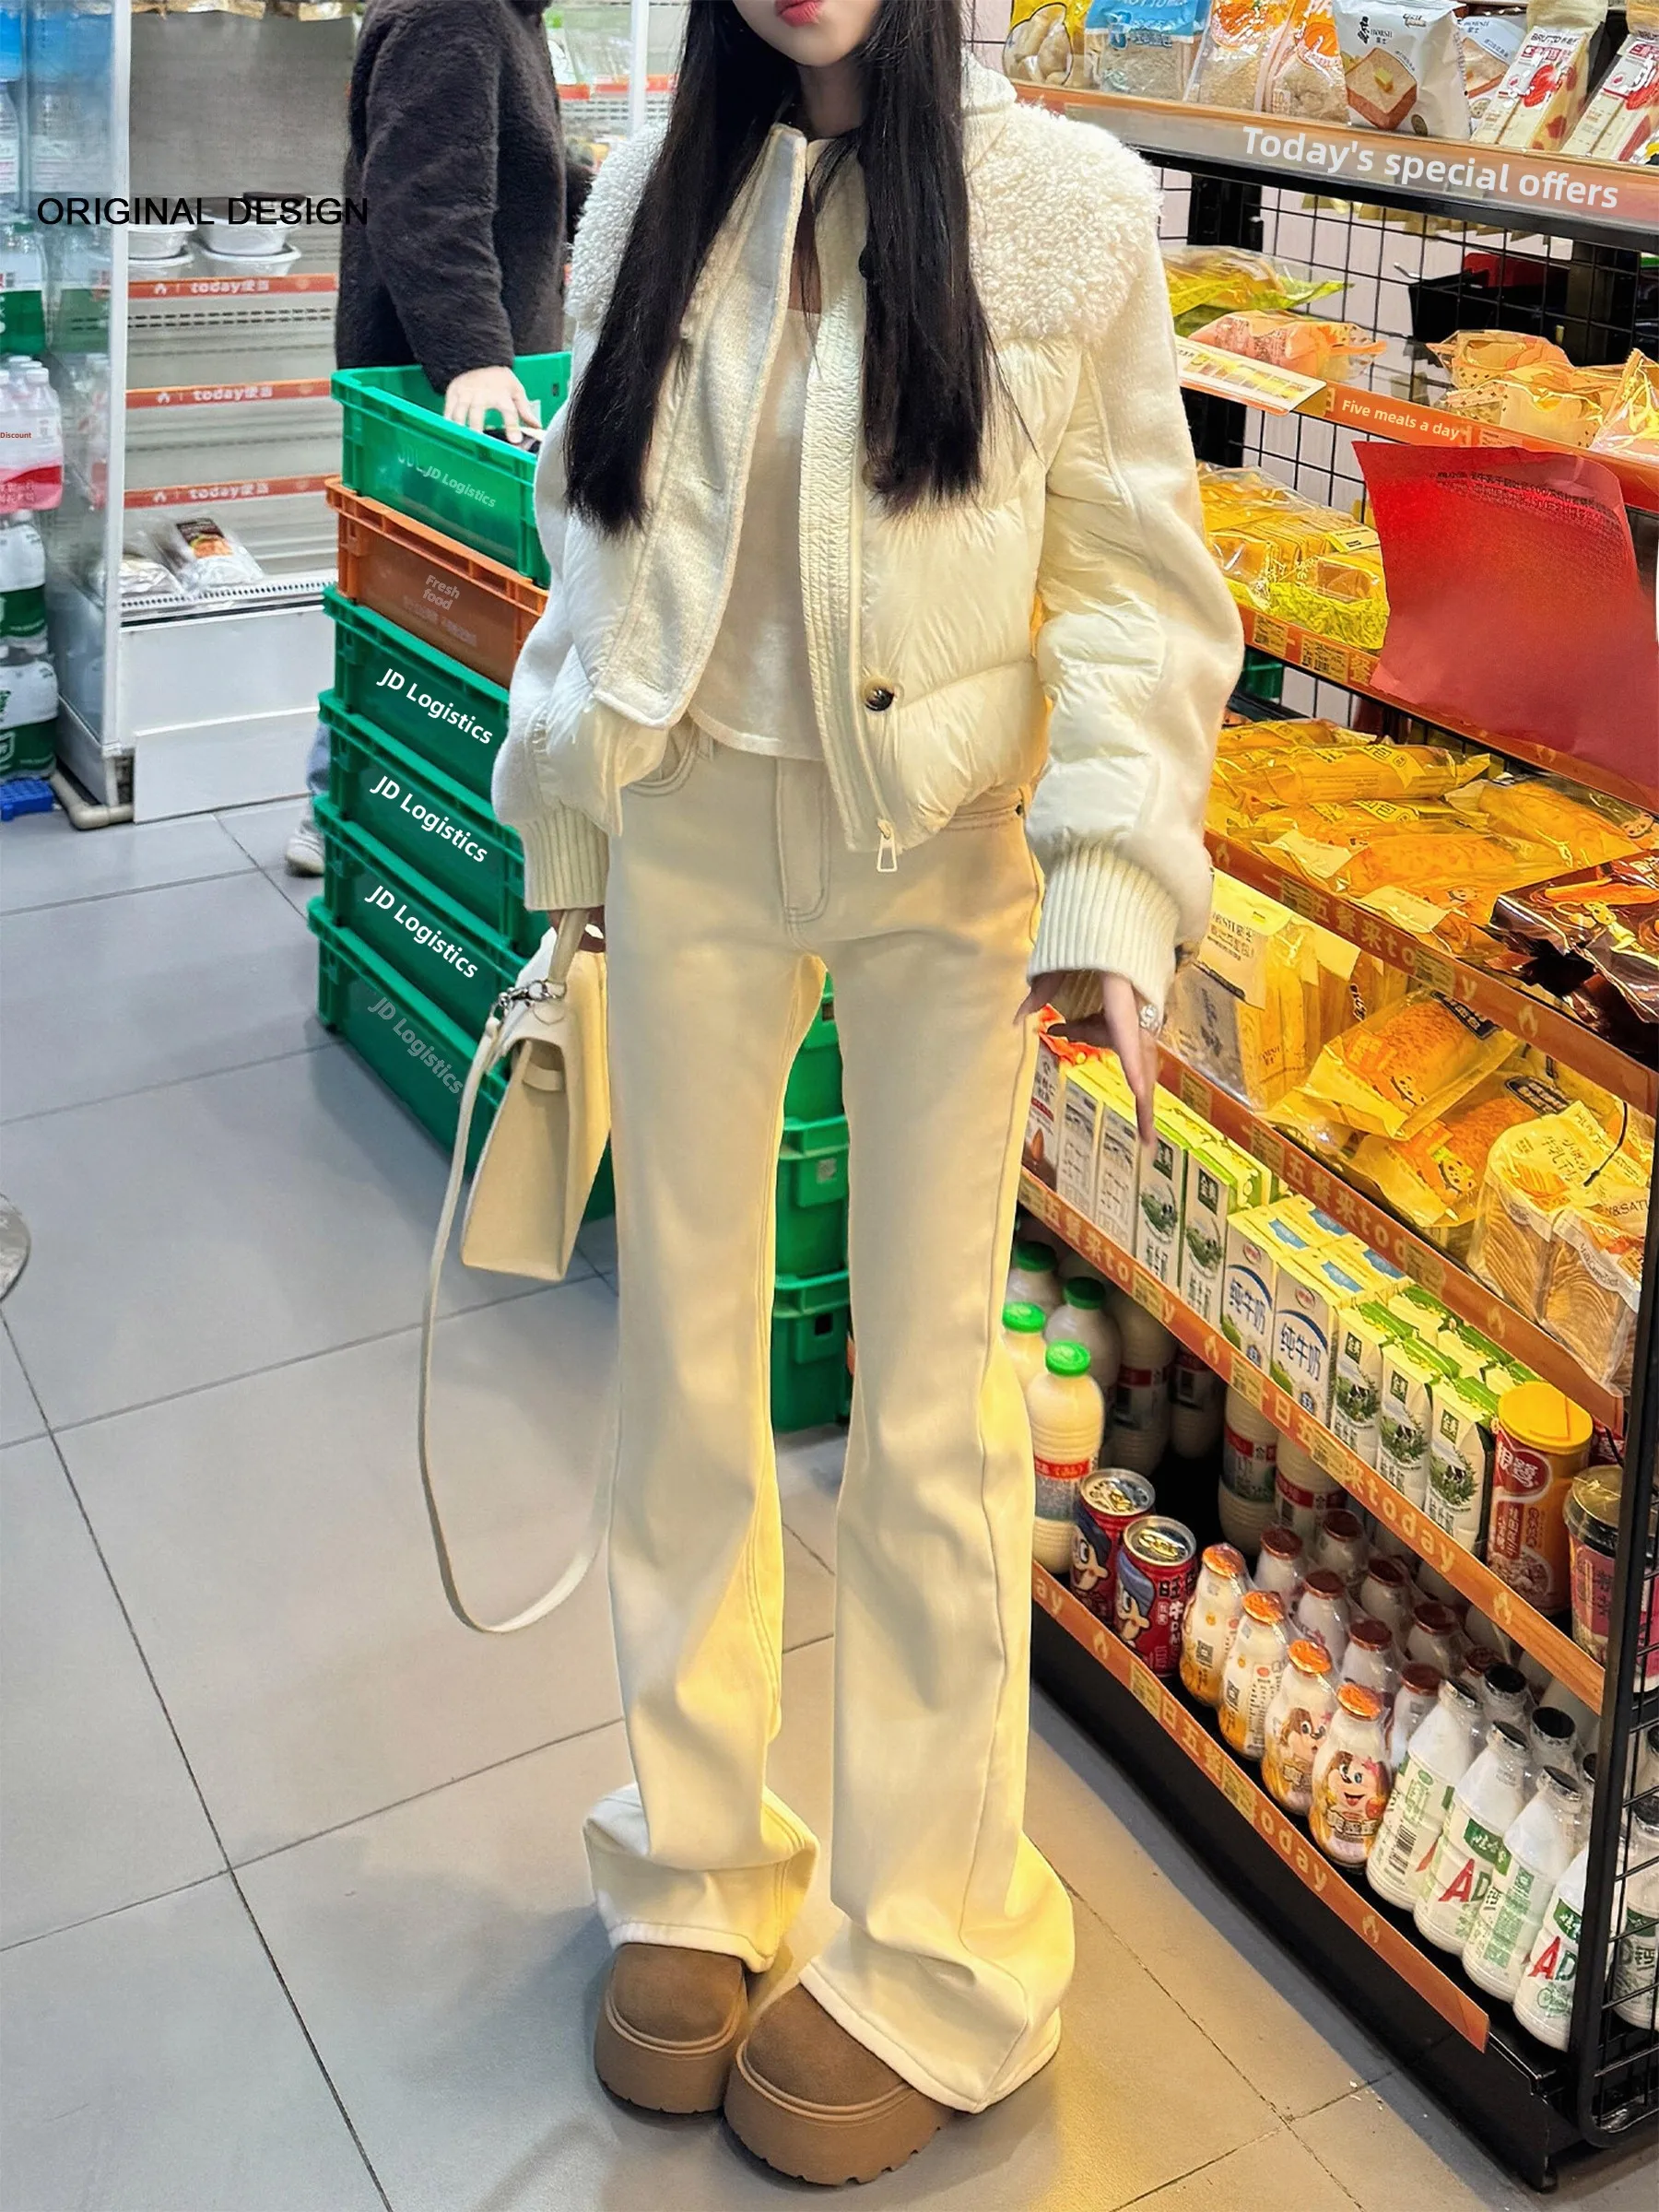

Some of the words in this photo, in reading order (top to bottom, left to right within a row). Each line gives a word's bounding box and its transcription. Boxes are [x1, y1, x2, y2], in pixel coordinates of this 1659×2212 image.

[1243, 125, 1373, 175] Today's
[1382, 150, 1509, 194] special
[1518, 171, 1618, 209] offers
[0, 431, 32, 440] Discount
[1342, 399, 1371, 418] Five
[1374, 408, 1417, 429] meals
[1419, 422, 1429, 432] a
[1432, 423, 1460, 441] day
[422, 465, 441, 479] JD
[442, 474, 497, 508] Logistics
[422, 588, 453, 611] food
[426, 574, 460, 600] Fresh
[376, 668, 406, 691] JD
[406, 683, 493, 745] Logistics
[370, 775, 400, 801] JD
[400, 793, 488, 863] Logistics
[365, 885, 395, 911] JD
[394, 904, 478, 978] Logistics
[368, 996, 396, 1020] JD
[393, 1018, 464, 1095] Logistics
[1229, 1277, 1265, 1335] 纯牛奶
[1280, 1323, 1322, 1382] 纯牛奶
